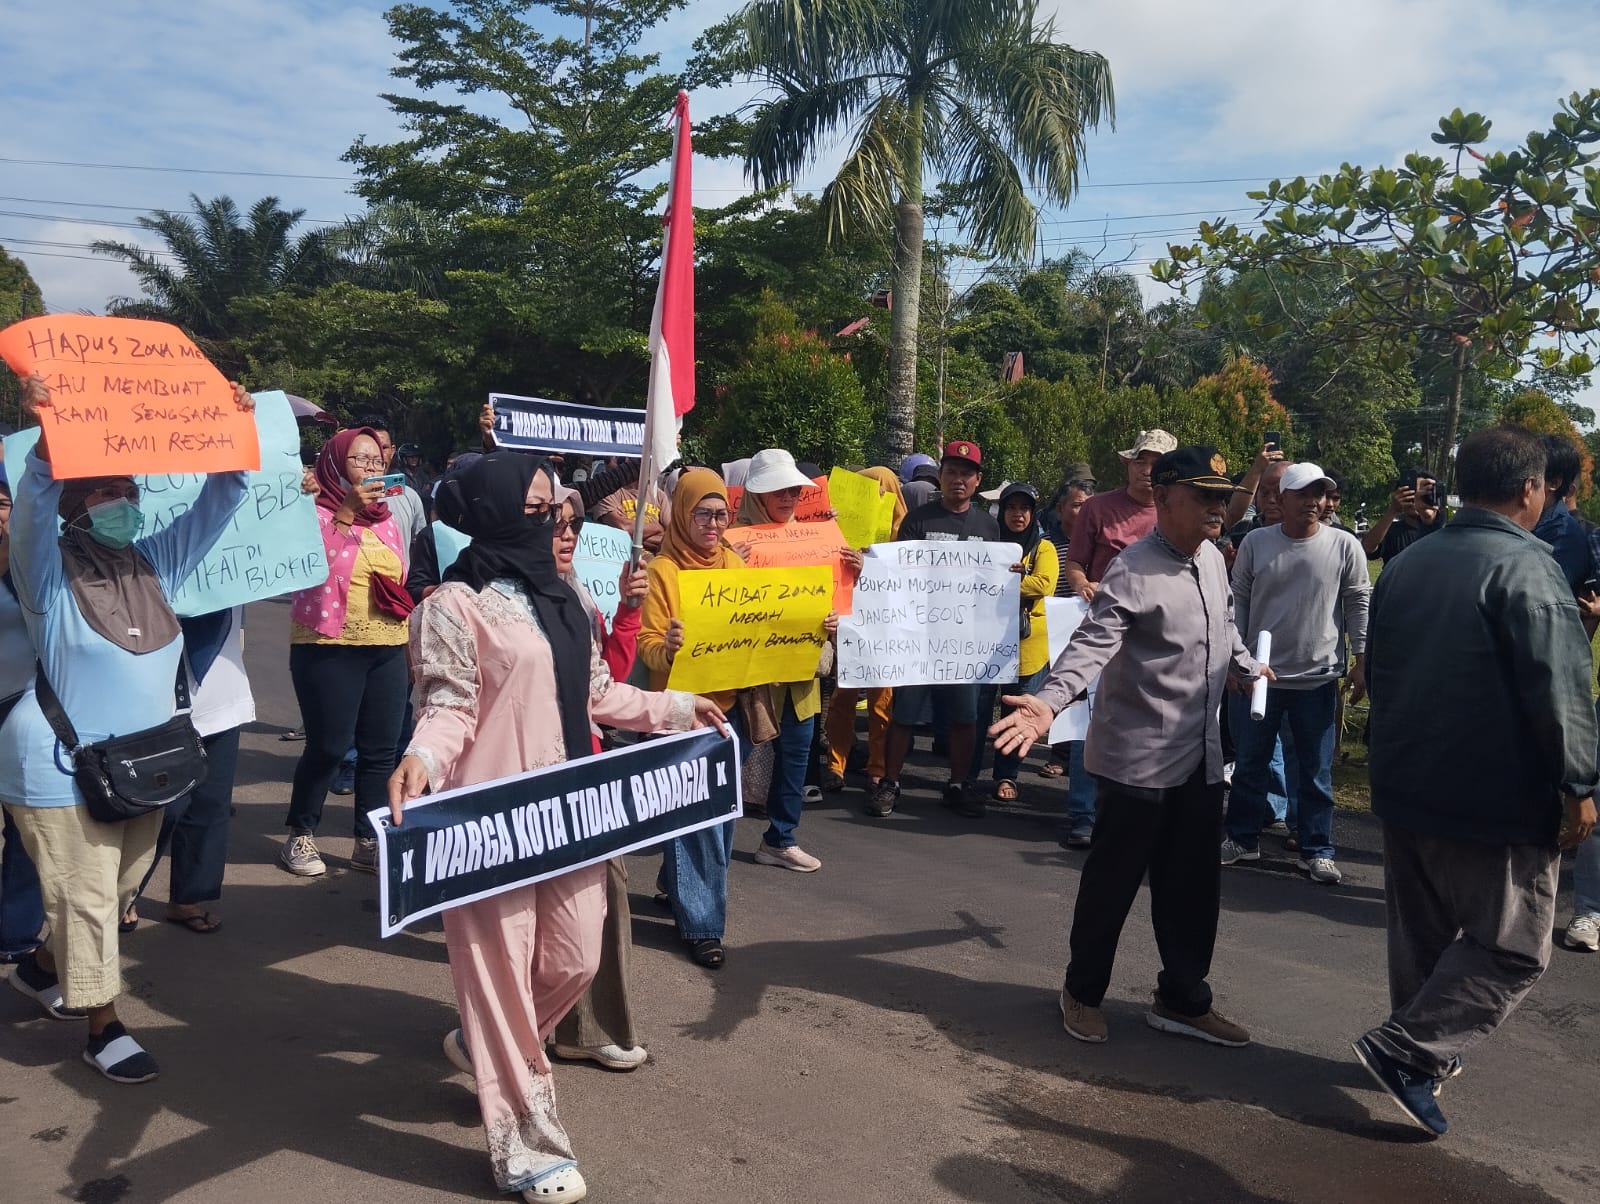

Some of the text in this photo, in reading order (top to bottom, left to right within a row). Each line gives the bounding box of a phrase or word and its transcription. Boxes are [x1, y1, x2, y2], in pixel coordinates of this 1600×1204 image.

[127, 338, 175, 359] ZONA
[179, 346, 208, 360] ME
[104, 376, 207, 397] MEMBUAT
[53, 403, 109, 425] KAMI
[512, 410, 553, 438] WARGA
[553, 415, 581, 441] KOTA
[581, 418, 613, 444] TIDAK
[104, 429, 235, 456] KAMI RESAH
[247, 544, 262, 561] DI
[578, 534, 630, 561] MERAH
[898, 546, 993, 567] PERTAMINA
[246, 552, 323, 593] BLOKIR
[700, 581, 772, 607] AKIBAT
[777, 583, 827, 600] ZONA
[859, 575, 1005, 597] BUKAN MUSUH WARGA
[729, 608, 784, 625] MERAH
[853, 605, 907, 627] JANGAN
[691, 636, 759, 658] EKONOMI
[857, 638, 1018, 658] PIKIRKAN NASIB WARGA
[853, 664, 906, 681] JANGAN
[424, 811, 514, 885] WARGA
[511, 795, 568, 860] KOTA
[566, 779, 630, 842] TIDAK
[629, 756, 711, 822] BAHAGIA
